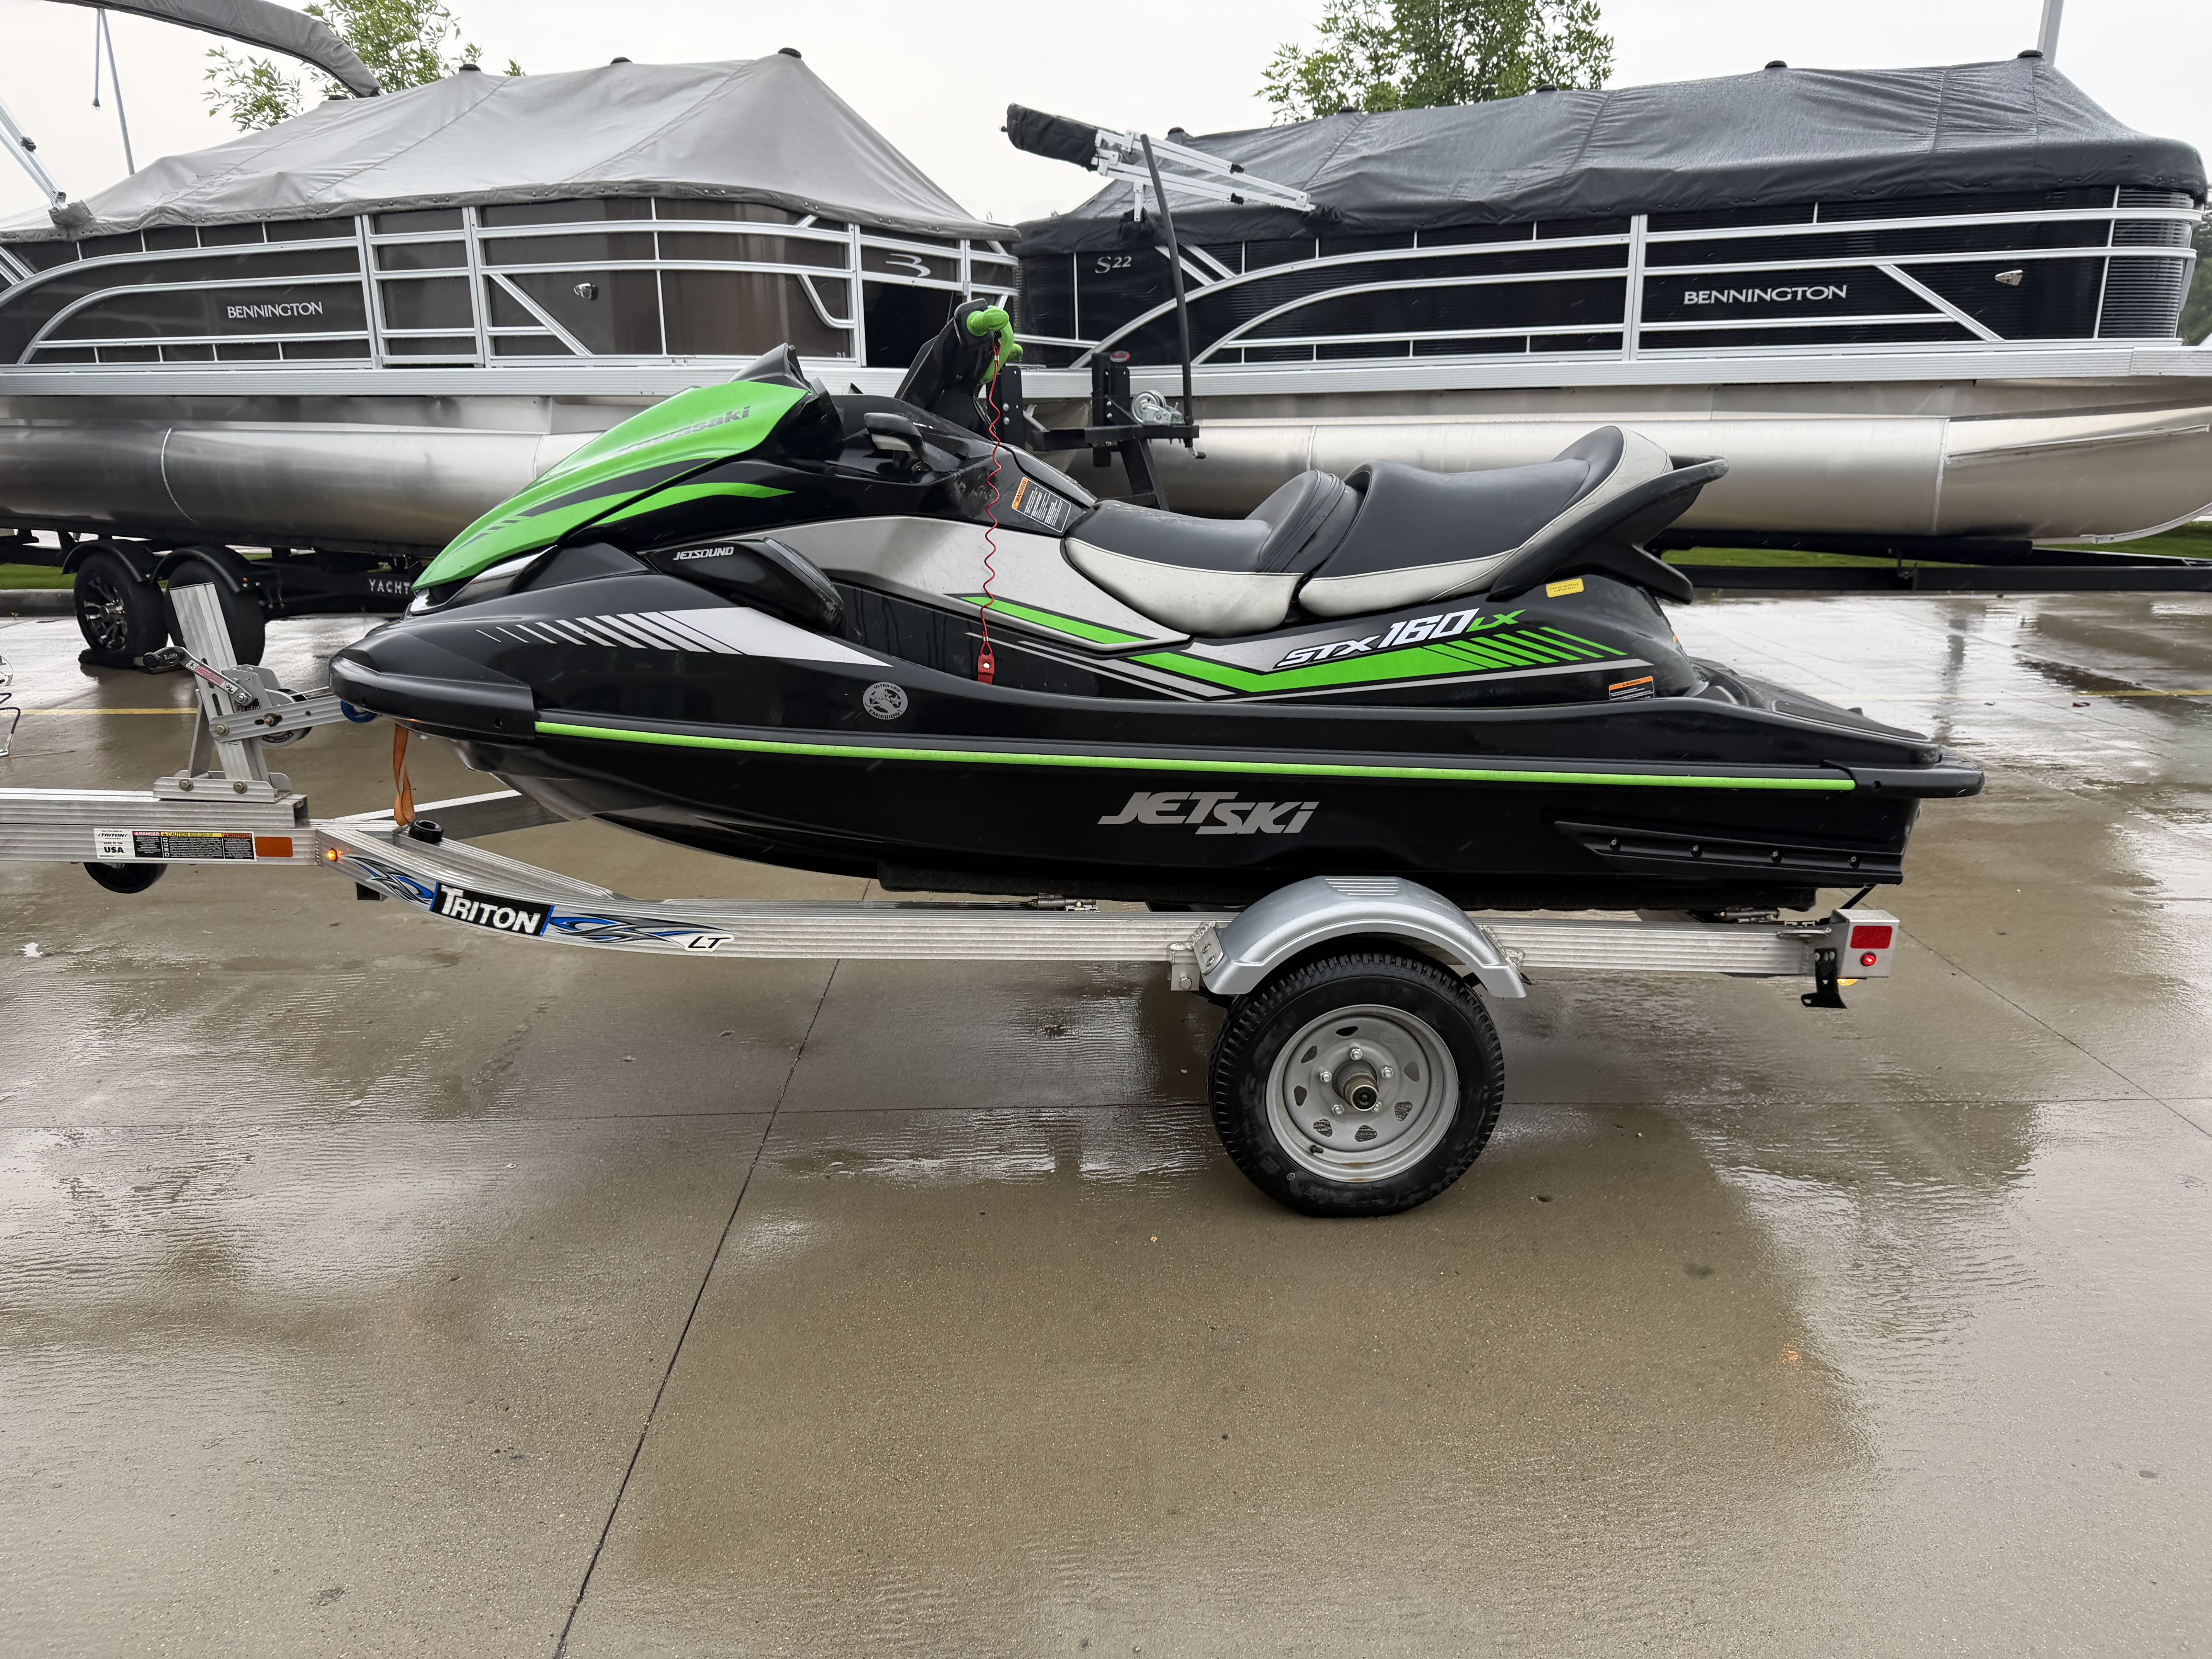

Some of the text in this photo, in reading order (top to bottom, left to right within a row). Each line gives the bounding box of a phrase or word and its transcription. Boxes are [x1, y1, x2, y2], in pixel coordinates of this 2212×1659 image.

[1095, 256, 1132, 273] S22
[1683, 285, 1847, 305] BENNINGTON
[227, 301, 323, 318] BENNINGTON
[673, 546, 734, 561] JETSOUND
[369, 578, 410, 595] YACHT
[1276, 608, 1526, 667] STX 160 LX
[441, 885, 541, 934] TRITON
[688, 936, 731, 949] LT
